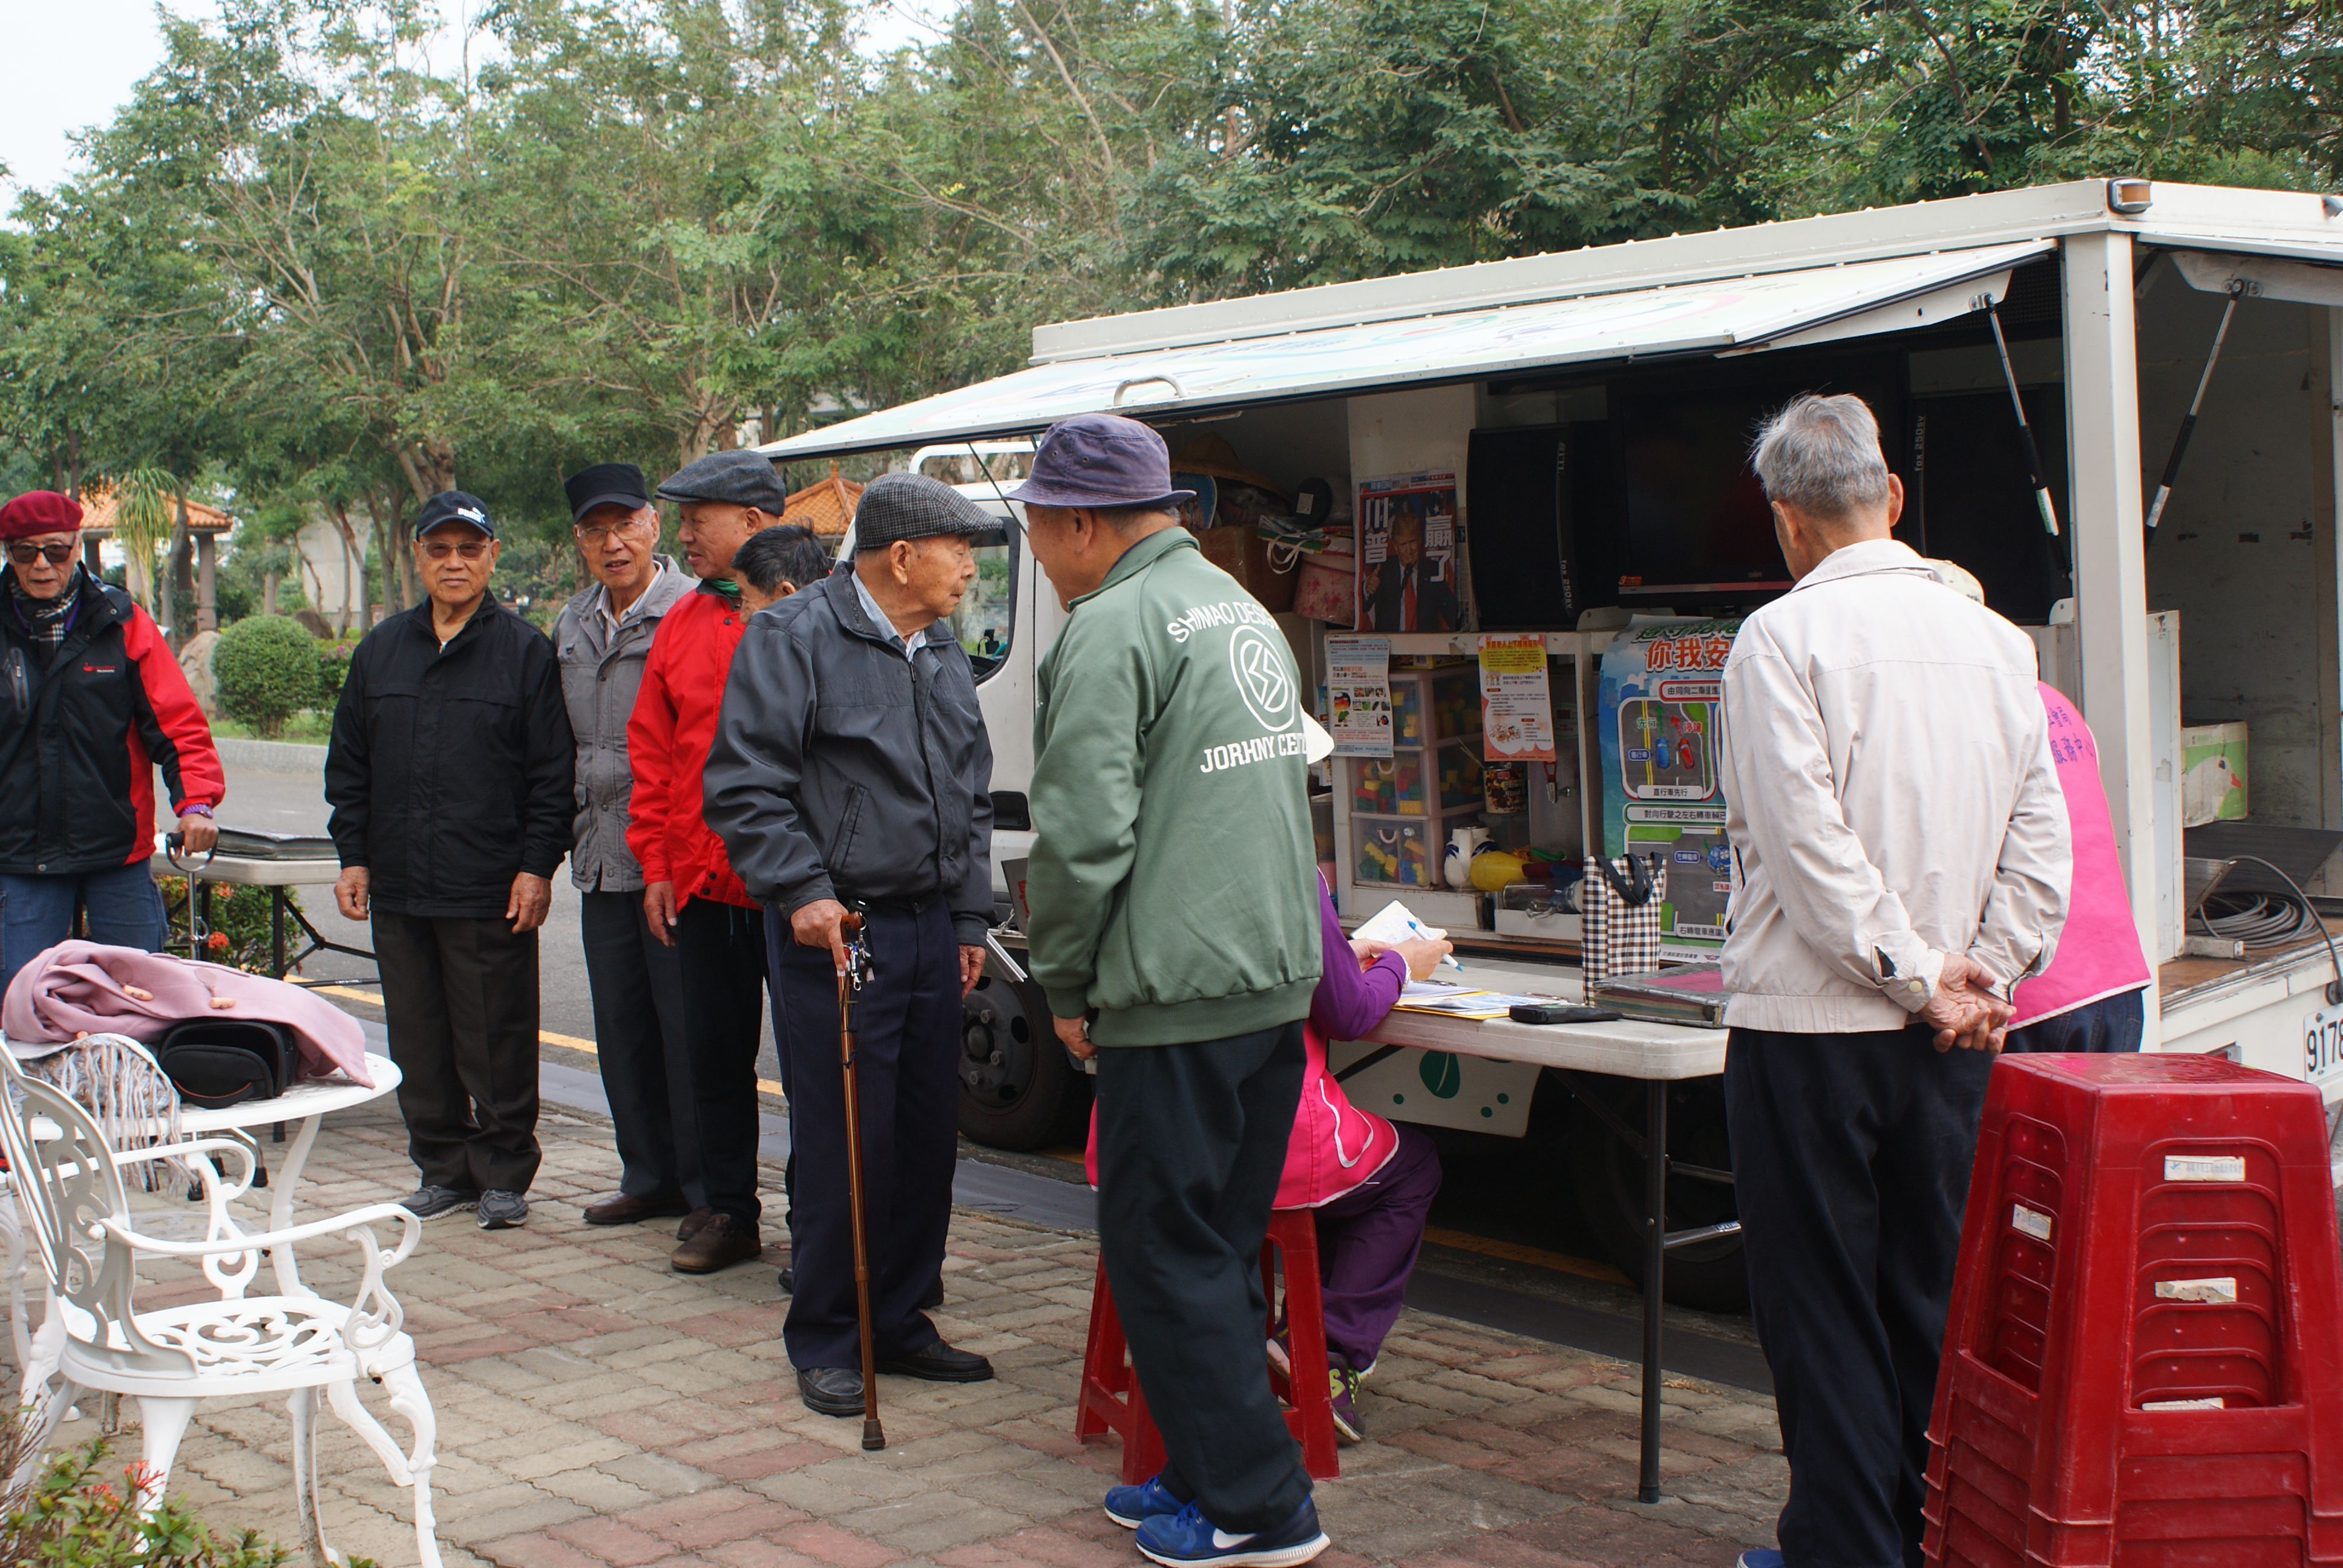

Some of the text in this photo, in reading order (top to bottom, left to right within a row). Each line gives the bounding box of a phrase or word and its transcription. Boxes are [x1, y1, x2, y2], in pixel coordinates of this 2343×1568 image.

[1365, 497, 1389, 564] 川普
[1425, 515, 1453, 583] 贏了
[1167, 602, 1236, 643] SHIMAO
[1200, 736, 1276, 773] JORHNY
